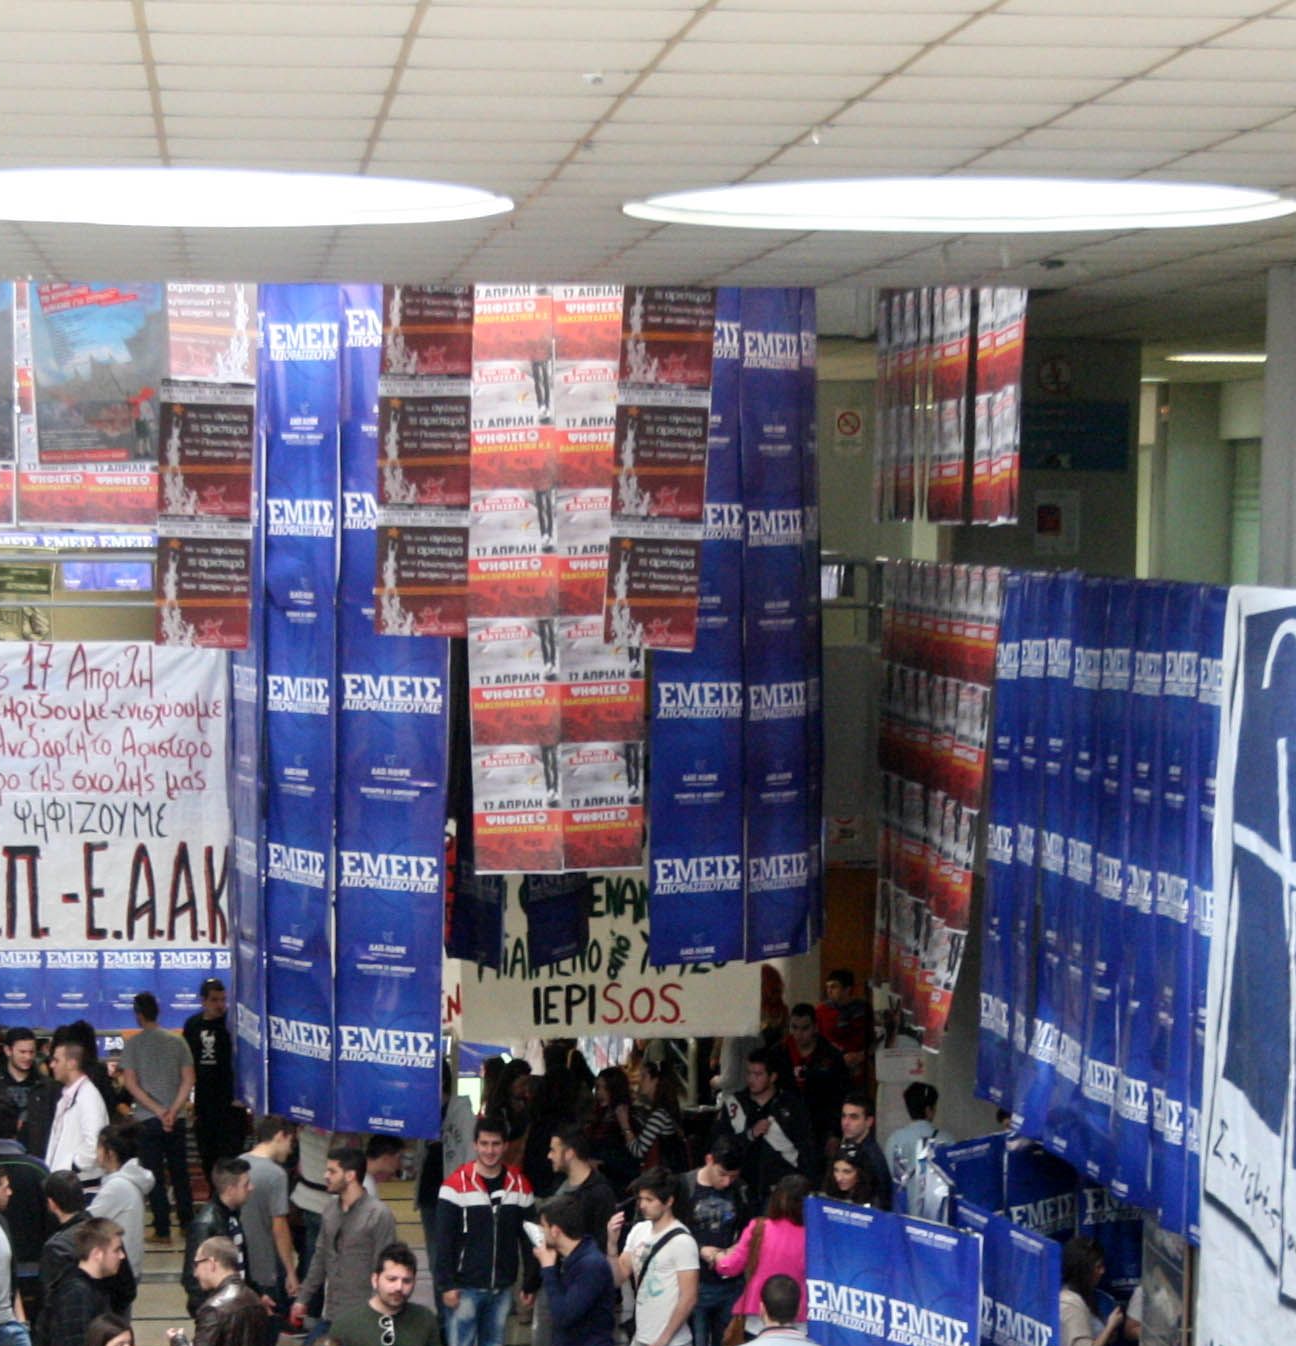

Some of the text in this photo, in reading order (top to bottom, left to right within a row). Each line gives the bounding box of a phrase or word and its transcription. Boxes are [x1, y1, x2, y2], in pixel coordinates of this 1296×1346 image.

[22, 643, 54, 690] 17
[66, 643, 154, 702] Απρίλη
[342, 674, 442, 702] ΕΜΕΙΣ
[342, 700, 441, 714] ΑΠΟΦΑΣΙΖΟΥΜΕ
[658, 682, 743, 707] ΕΜΕΙΣ
[29, 762, 64, 792] της
[165, 769, 207, 800] μας
[13, 797, 169, 843] ΨΗΦΙΖΟΥΜΕ
[340, 851, 439, 882] ΕΜΕΙΣ
[654, 855, 740, 883] ΕΜΕΙΣ
[340, 876, 437, 893] ΑΠΟΦΑΣΙΖΟΥΜΕ
[338, 1026, 435, 1057] ΕΜΕΙΣ
[807, 1279, 885, 1323] ΕΜΕΙΣ
